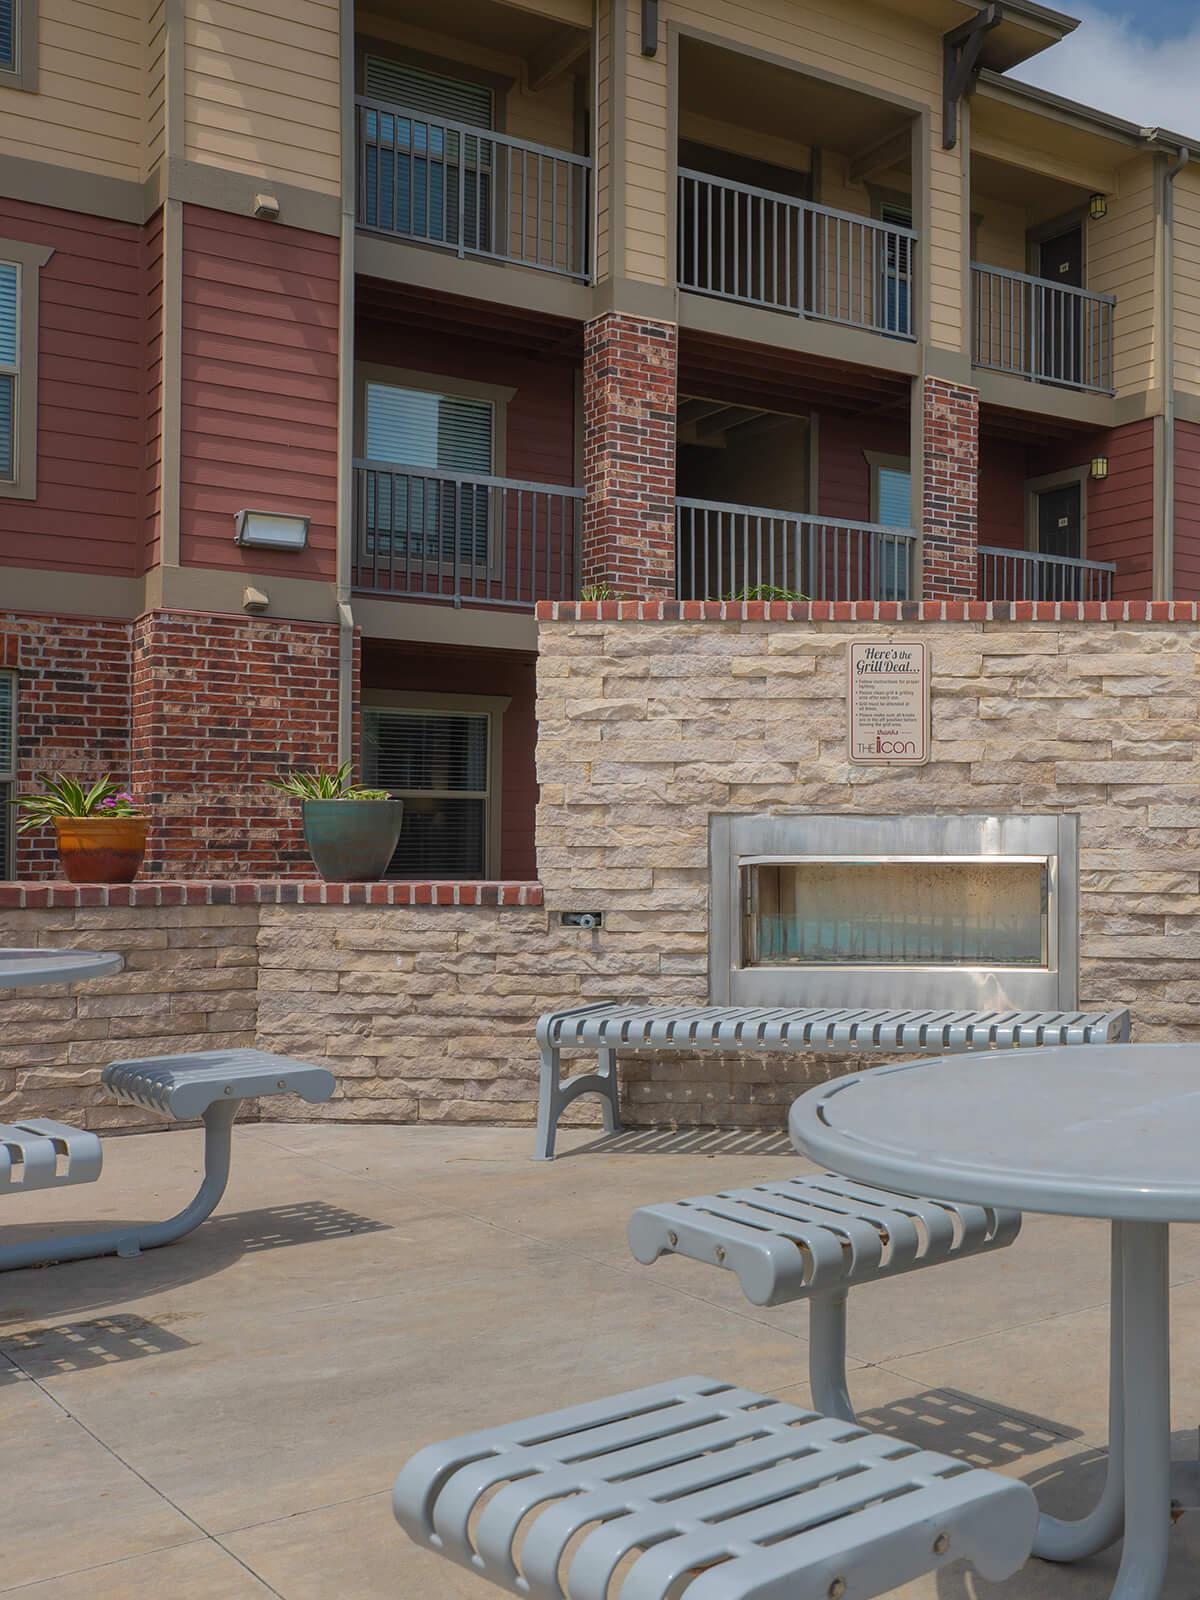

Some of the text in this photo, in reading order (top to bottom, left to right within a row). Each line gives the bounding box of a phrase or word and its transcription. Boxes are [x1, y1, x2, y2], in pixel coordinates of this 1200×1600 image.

[864, 647, 912, 660] Here's the
[856, 659, 920, 675] Grill Deal...
[857, 735, 915, 754] THE icon
